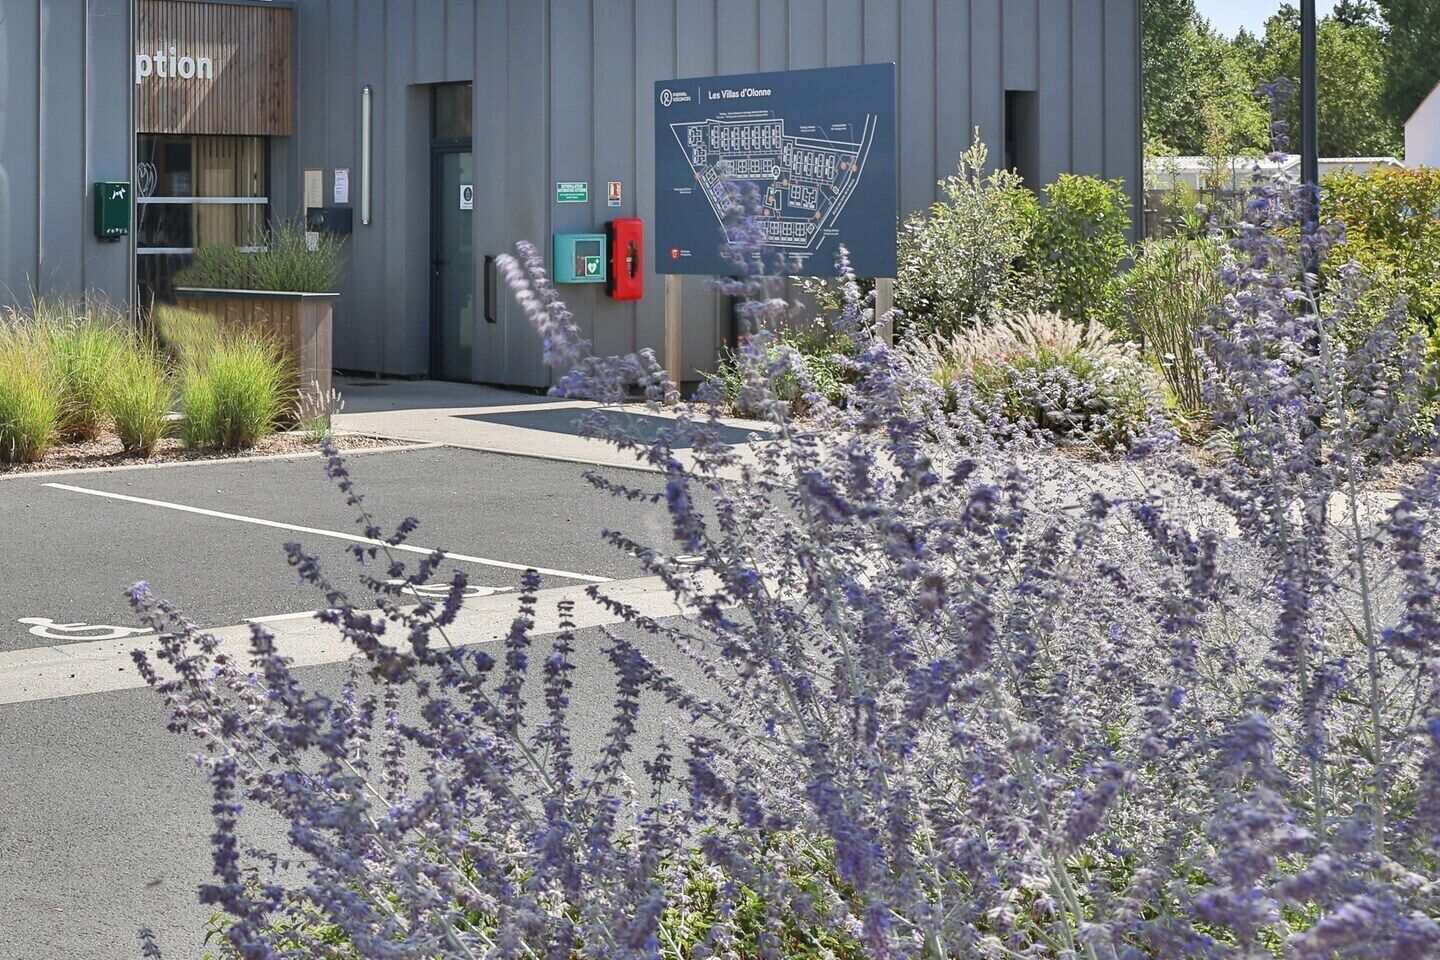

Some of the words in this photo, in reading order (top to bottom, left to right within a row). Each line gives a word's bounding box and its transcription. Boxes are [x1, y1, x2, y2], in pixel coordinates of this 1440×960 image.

[136, 46, 213, 84] ption
[708, 91, 720, 99] Les
[721, 90, 739, 98] Villas
[740, 88, 771, 97] d'Olonne
